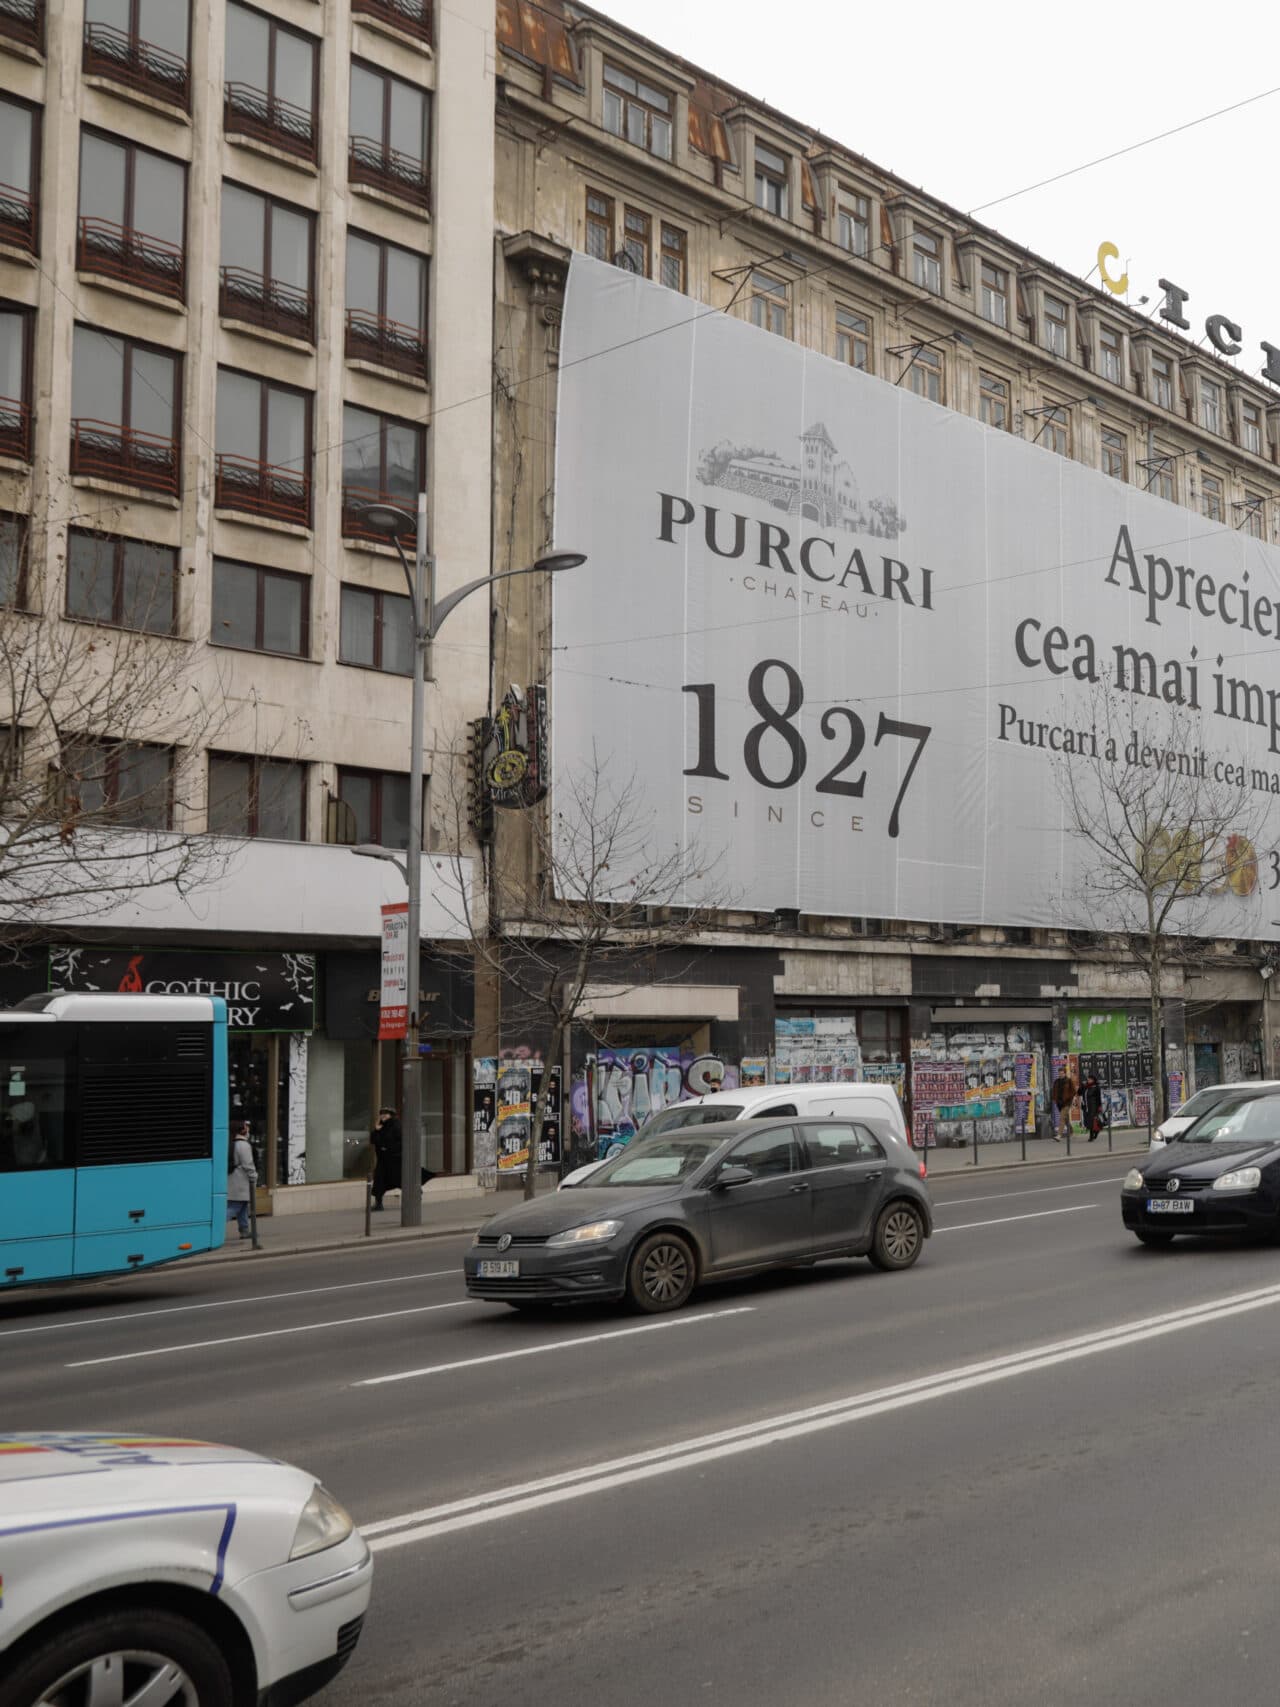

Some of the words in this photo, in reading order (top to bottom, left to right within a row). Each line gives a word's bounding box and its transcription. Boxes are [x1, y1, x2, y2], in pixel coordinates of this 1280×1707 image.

[656, 491, 934, 611] PURCARI
[743, 576, 868, 618] CHATEAU
[1015, 618, 1100, 684] cea
[1111, 645, 1201, 710] mai
[681, 659, 932, 838] 1827
[997, 703, 1101, 760] Purcari
[1105, 738, 1118, 763] a
[1125, 730, 1208, 779] devenit
[1214, 760, 1247, 788] cea
[688, 796, 864, 832] SINCE
[145, 978, 261, 1000] GOTHIC
